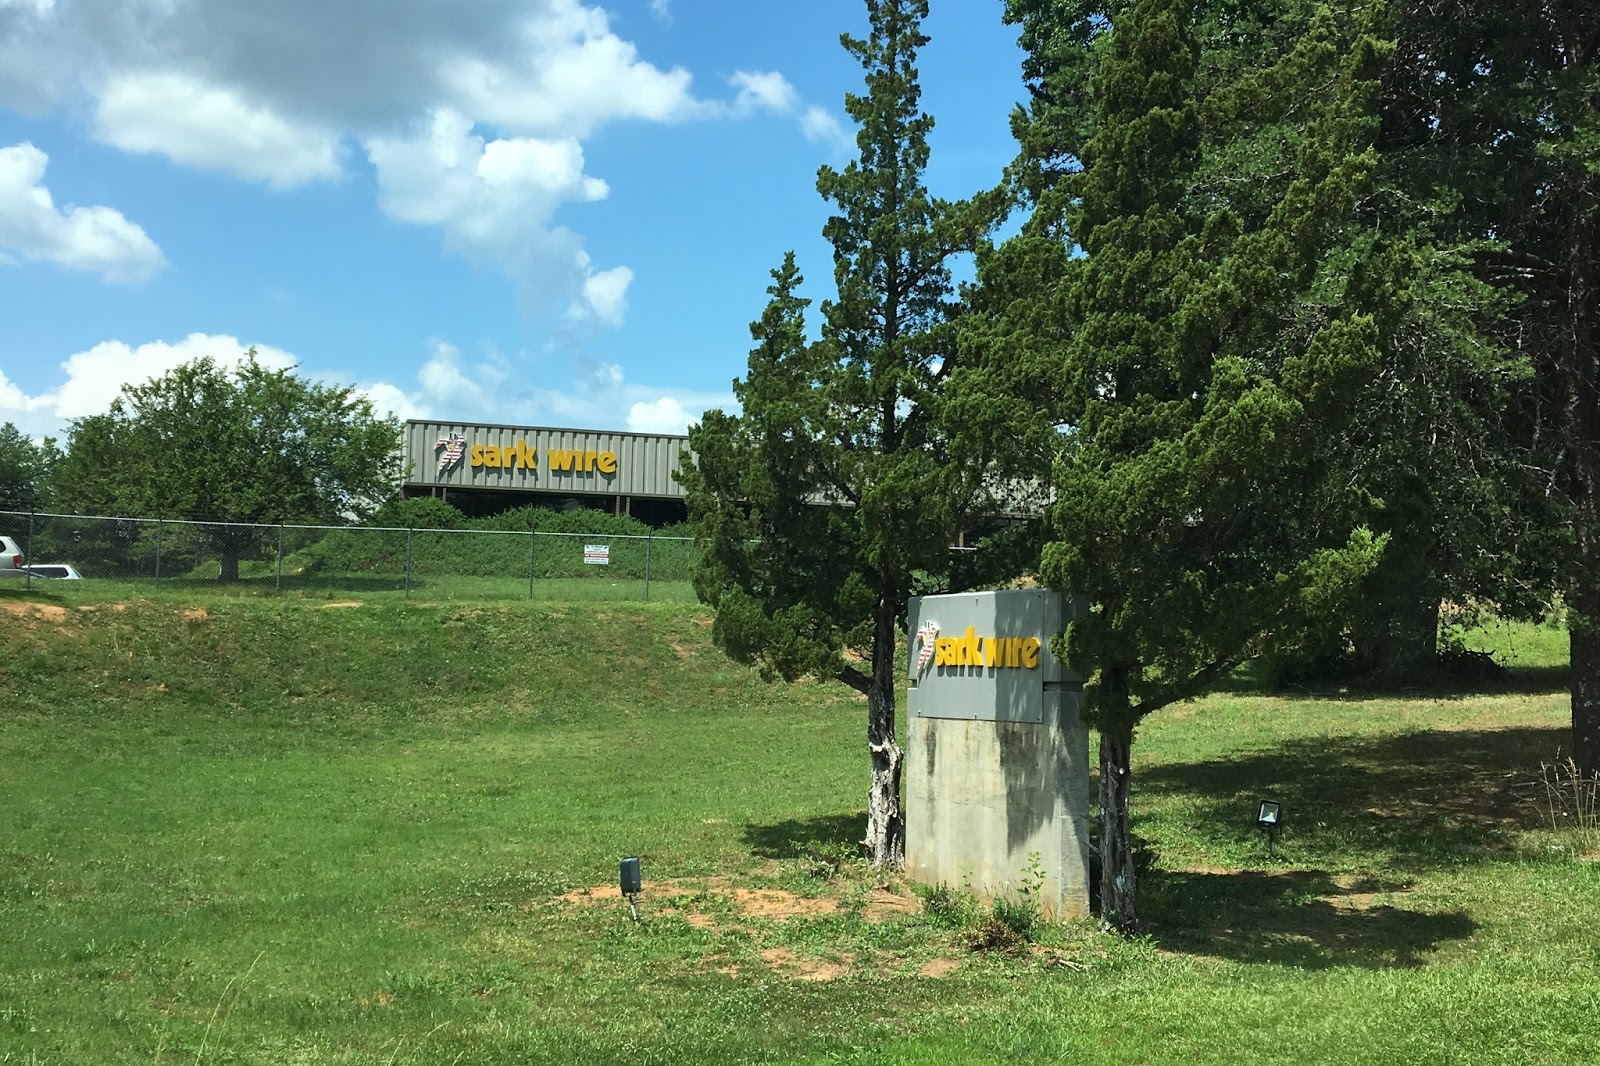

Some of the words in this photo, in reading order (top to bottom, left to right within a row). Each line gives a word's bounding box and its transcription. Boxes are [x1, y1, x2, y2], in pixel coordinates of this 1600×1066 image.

[471, 439, 537, 469] sark
[549, 449, 618, 474] wire
[935, 626, 984, 667] sark
[984, 636, 1041, 669] wire
